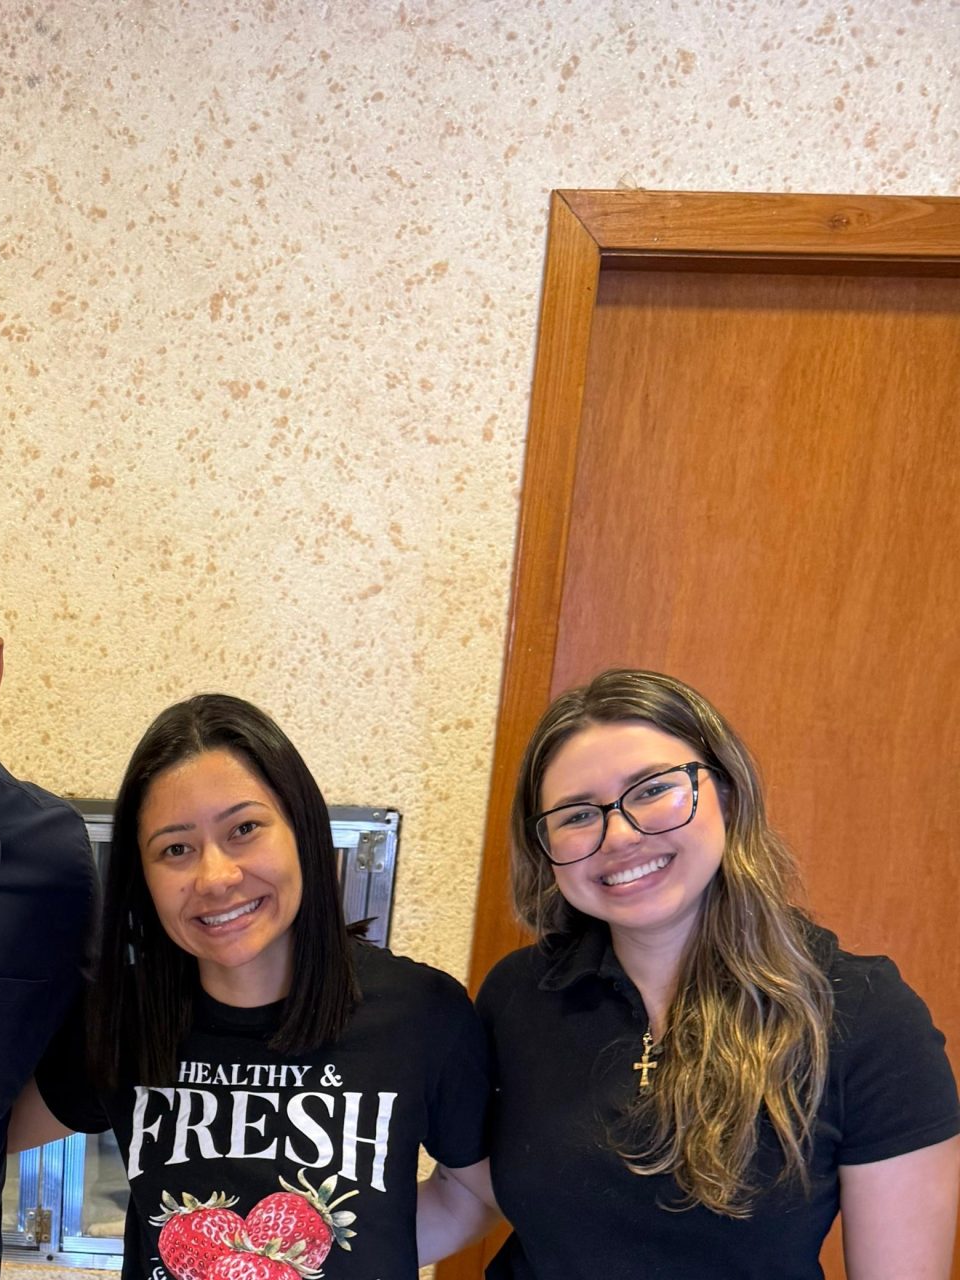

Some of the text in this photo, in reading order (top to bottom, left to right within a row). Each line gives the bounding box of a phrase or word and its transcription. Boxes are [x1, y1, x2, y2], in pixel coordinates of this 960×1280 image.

[178, 1061, 343, 1087] HEALTHY &
[127, 1085, 398, 1193] FRESH
